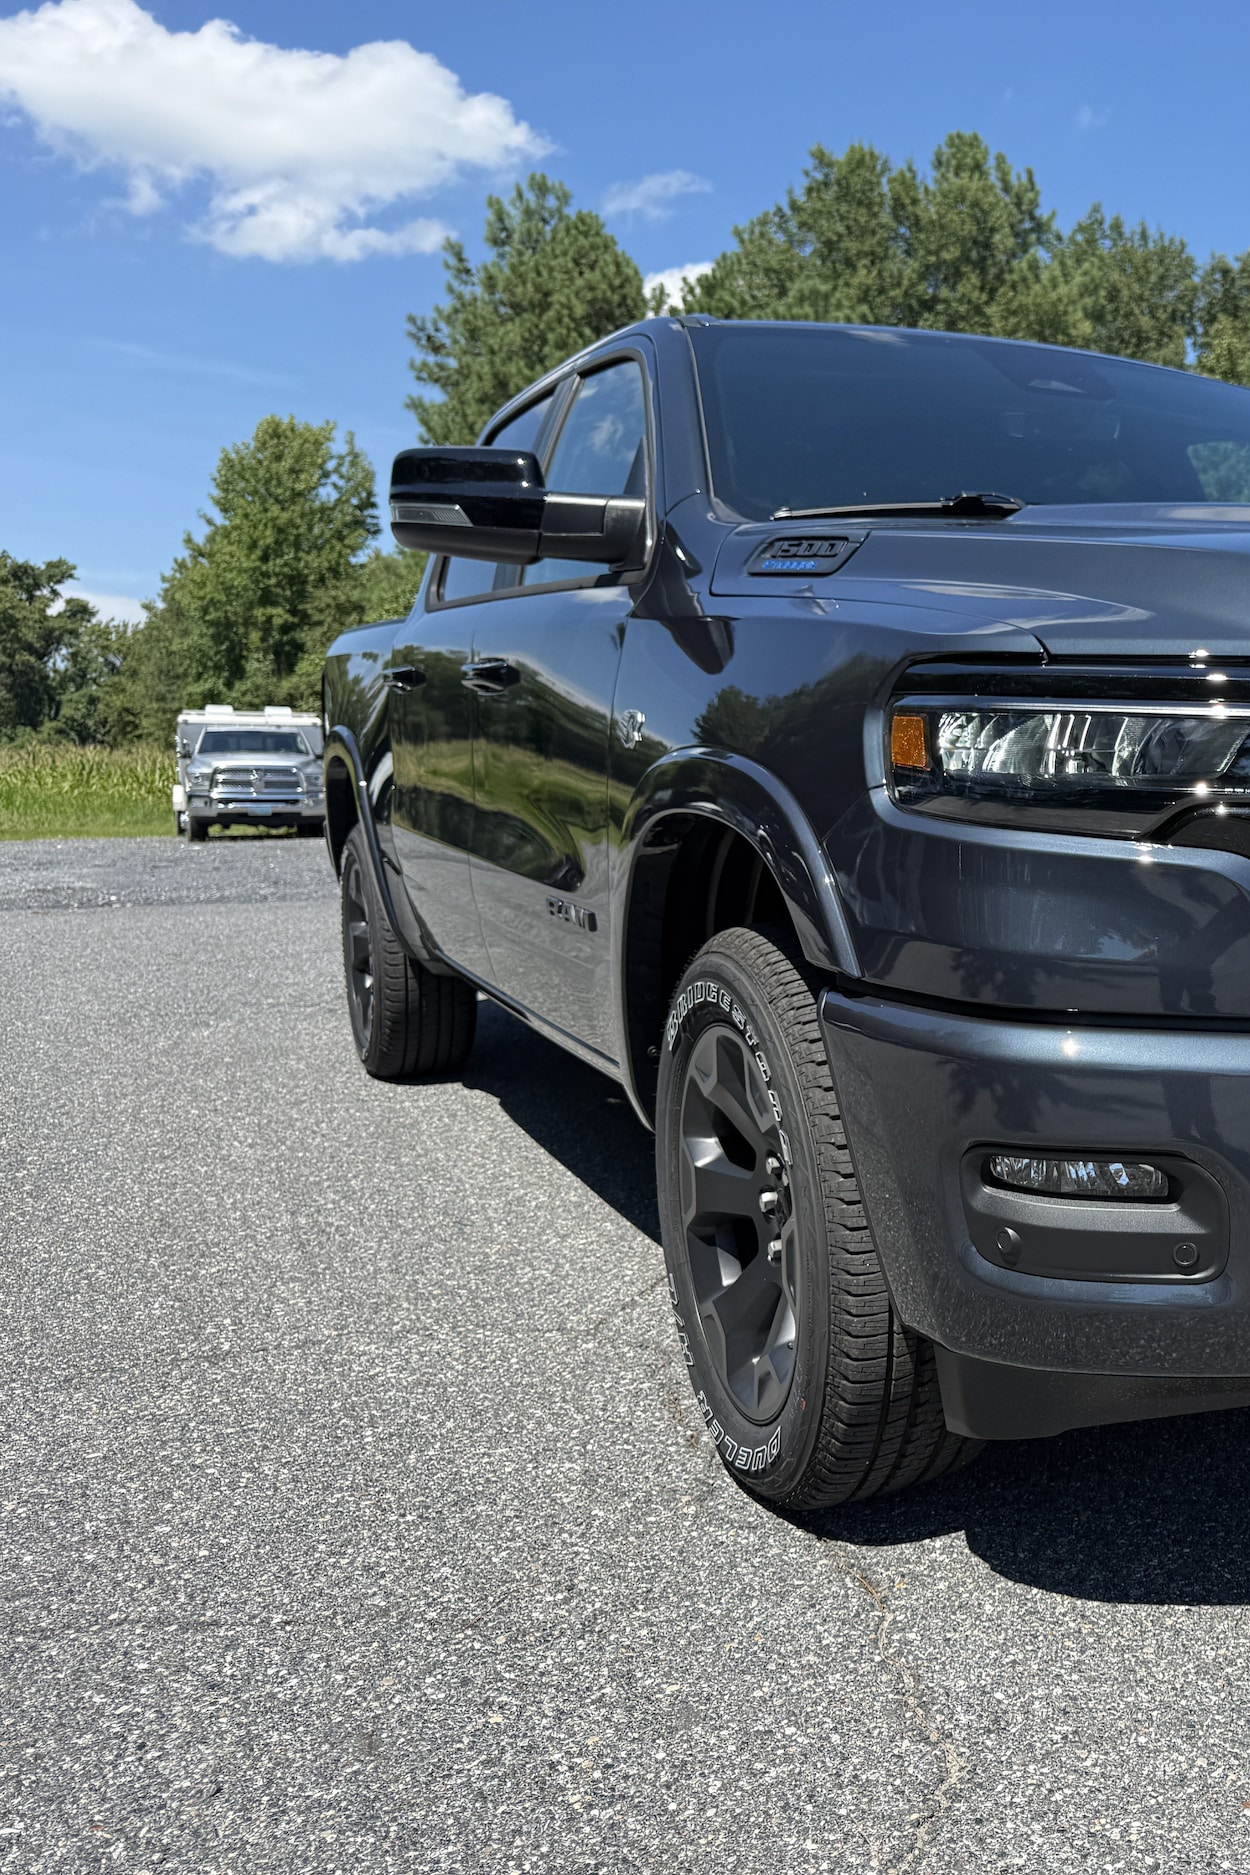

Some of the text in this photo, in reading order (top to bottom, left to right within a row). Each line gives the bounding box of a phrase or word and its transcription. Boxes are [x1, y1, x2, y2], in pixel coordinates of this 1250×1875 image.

[769, 540, 850, 558] 1500
[546, 895, 598, 932] RAM
[667, 980, 794, 1167] BRIDGESTONE
[699, 1390, 782, 1471] DUELER
